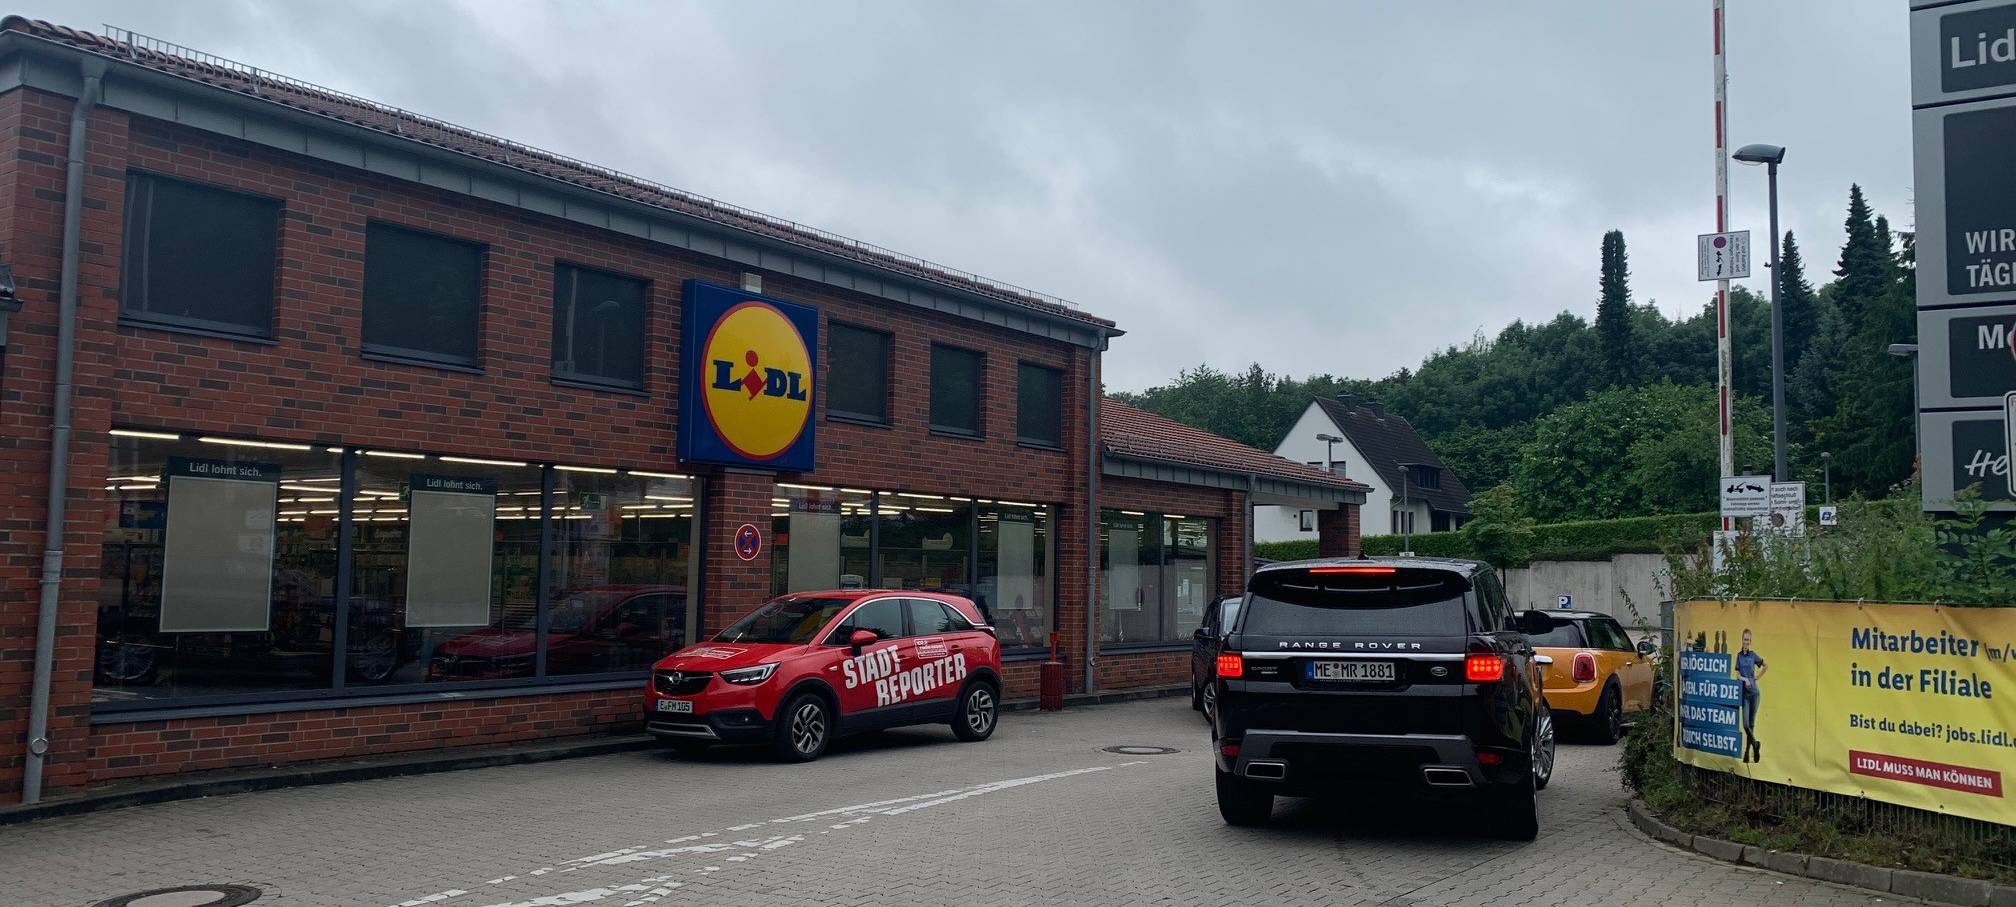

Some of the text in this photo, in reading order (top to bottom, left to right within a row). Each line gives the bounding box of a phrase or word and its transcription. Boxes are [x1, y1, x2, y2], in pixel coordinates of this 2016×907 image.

[190, 462, 262, 477] Lidl lohnt sich.
[426, 478, 441, 487] Lidl
[443, 480, 463, 489] lohnt
[1279, 641, 1421, 650] RANGE ROVER
[1852, 627, 1979, 657] Mitarbeiter
[842, 644, 901, 690] STADT
[1361, 664, 1393, 678] 1881
[875, 653, 967, 708] REPORTER
[1699, 680, 1718, 698] FÜR
[1720, 684, 1739, 700] DIE
[1851, 662, 1992, 699] in der Filiale
[1691, 706, 1706, 721] DAS
[1707, 708, 1736, 725] TEAM
[1850, 714, 1876, 730] Bist
[1879, 718, 1896, 733] du
[1899, 720, 1943, 738] dabei?
[1702, 732, 1738, 752] SELBST.
[1856, 757, 1993, 789] LIDL MUSS MAN KÖNNEN
